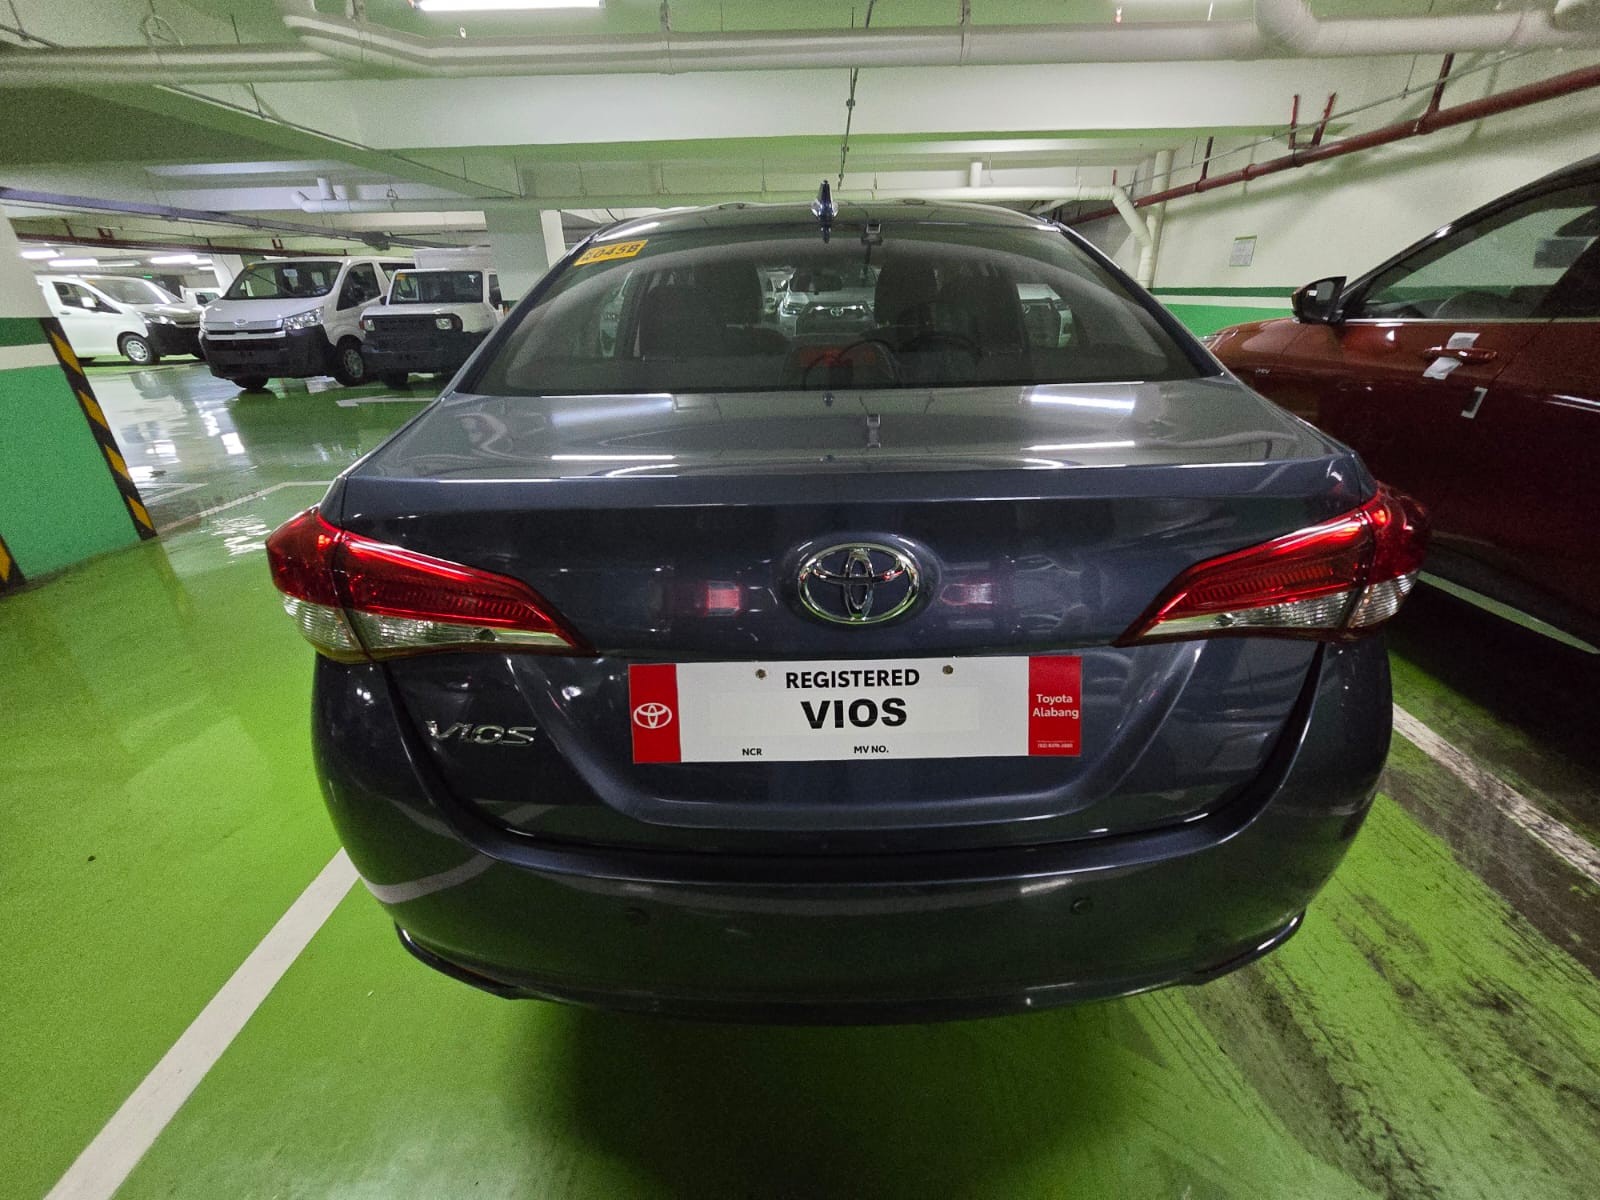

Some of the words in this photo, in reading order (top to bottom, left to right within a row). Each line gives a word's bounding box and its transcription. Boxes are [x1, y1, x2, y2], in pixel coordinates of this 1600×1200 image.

[785, 669, 920, 689] REGISTERED
[1036, 694, 1073, 705] Toyota
[801, 698, 908, 729] VIOS
[1032, 707, 1080, 720] Alabang
[425, 720, 537, 747] VIOS
[742, 748, 762, 757] NCR
[854, 746, 870, 755] MV
[871, 745, 890, 755] NO.
